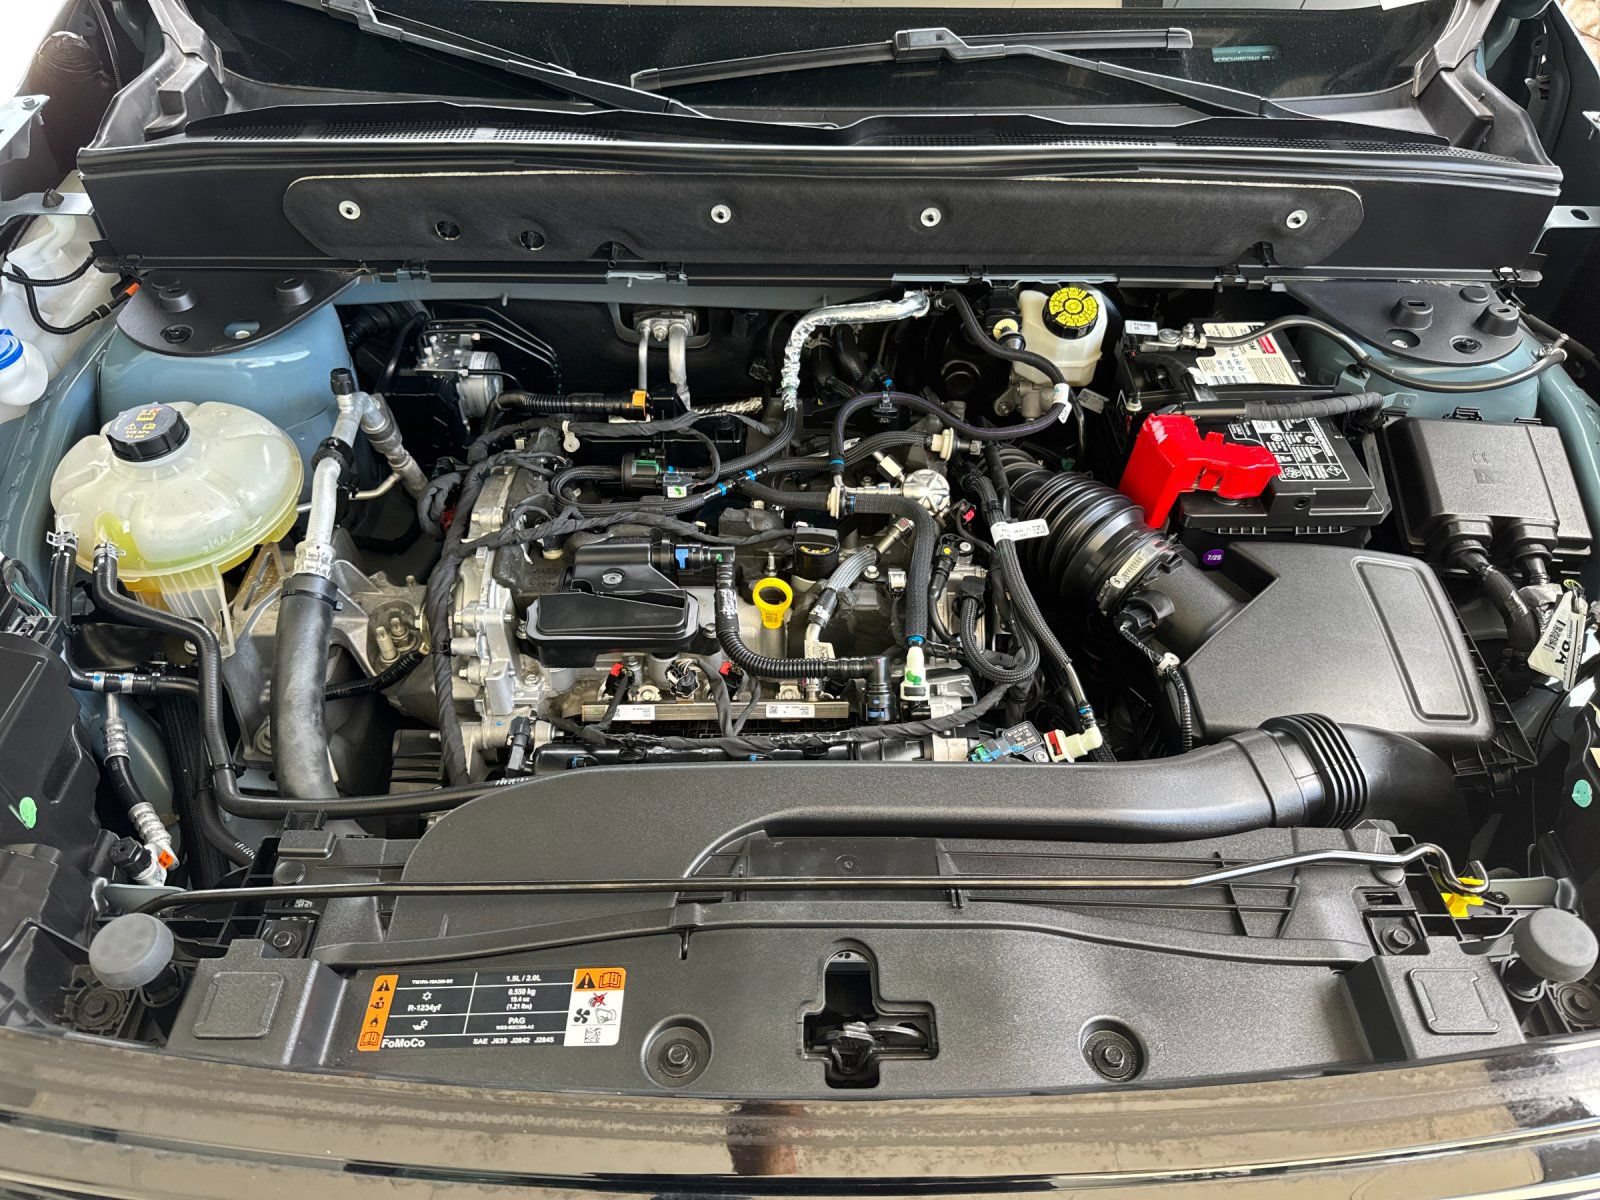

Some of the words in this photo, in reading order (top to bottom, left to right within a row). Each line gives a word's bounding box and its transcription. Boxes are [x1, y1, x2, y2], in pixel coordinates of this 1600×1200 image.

[506, 975, 520, 983] 1.5L
[526, 974, 542, 982] 2.0L
[508, 988, 525, 996] 0.550
[527, 988, 536, 997] kg
[407, 1003, 442, 1013] R-1234yf
[508, 1017, 526, 1025] PAG
[381, 1038, 426, 1049] FoMoCo
[490, 1037, 508, 1045] J639
[534, 1036, 555, 1044] J2845
